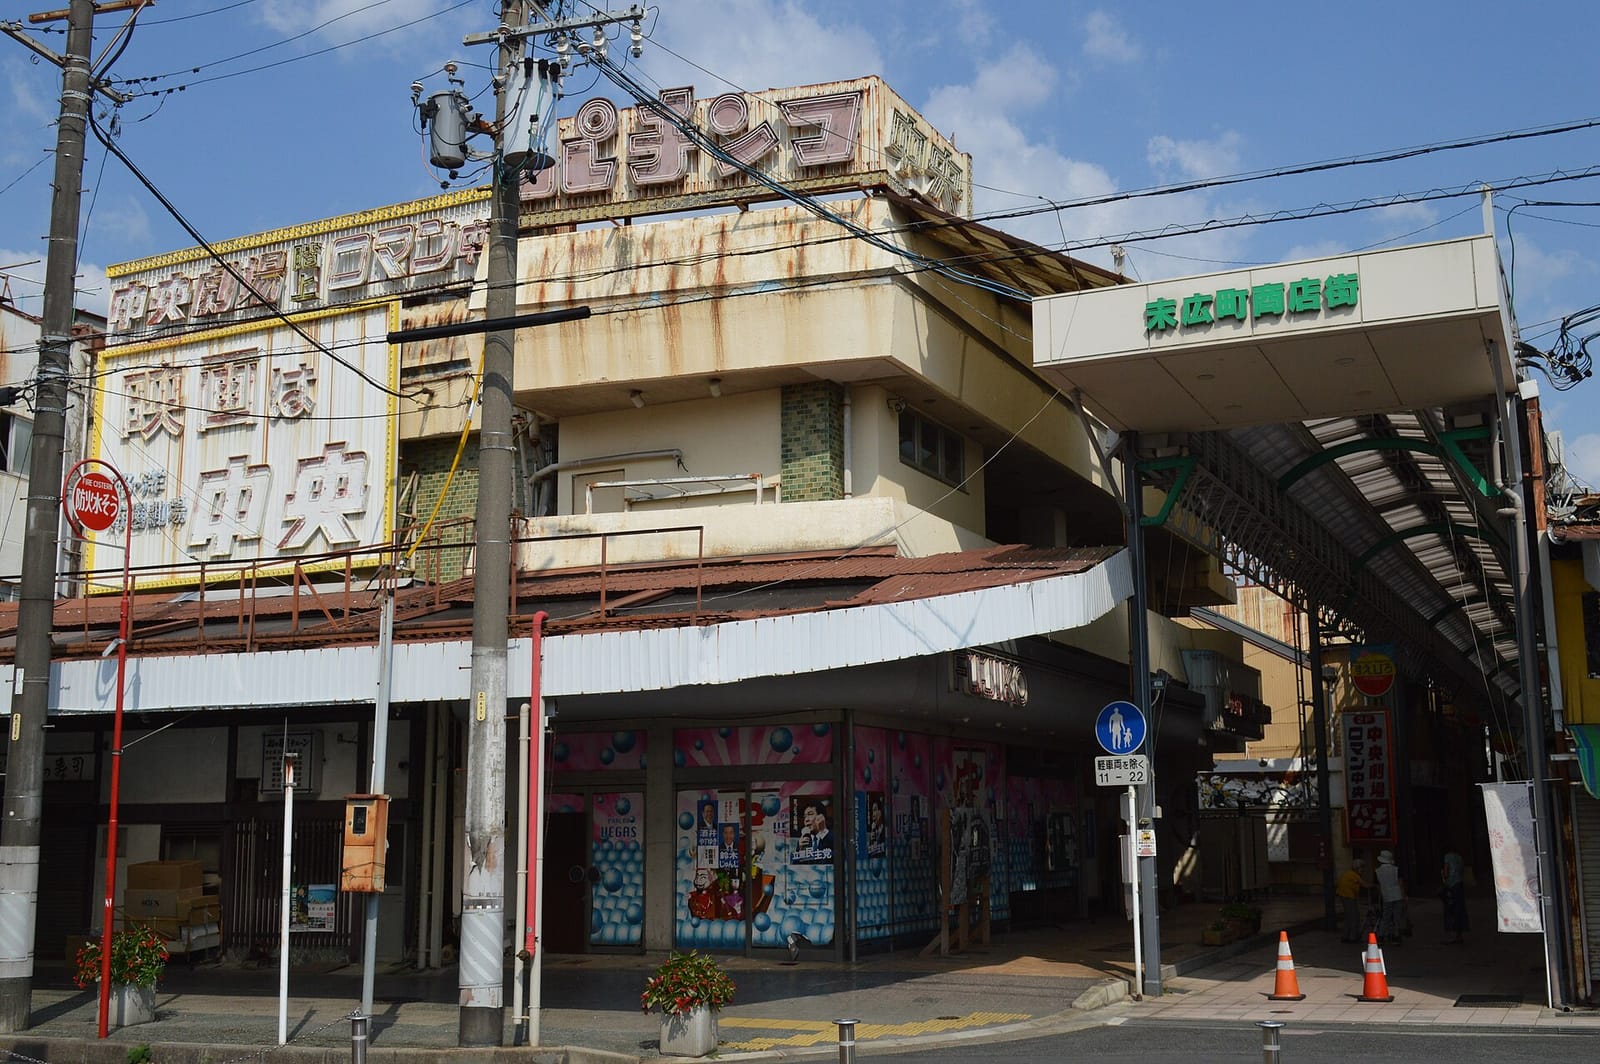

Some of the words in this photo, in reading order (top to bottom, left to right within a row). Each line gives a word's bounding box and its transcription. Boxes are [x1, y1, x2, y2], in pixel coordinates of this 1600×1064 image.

[885, 107, 963, 215] 中央
[109, 250, 287, 330] 中央劇場
[1145, 273, 1359, 331] 末広町商店街
[121, 347, 317, 441] 映画は
[75, 487, 118, 517] 防火水そう
[93, 480, 113, 491] CISTERN
[187, 441, 370, 559] 中央
[1097, 758, 1145, 771] 軽車両を除く
[1348, 727, 1365, 798] ロマン中央
[1367, 726, 1386, 798] 中央劇場
